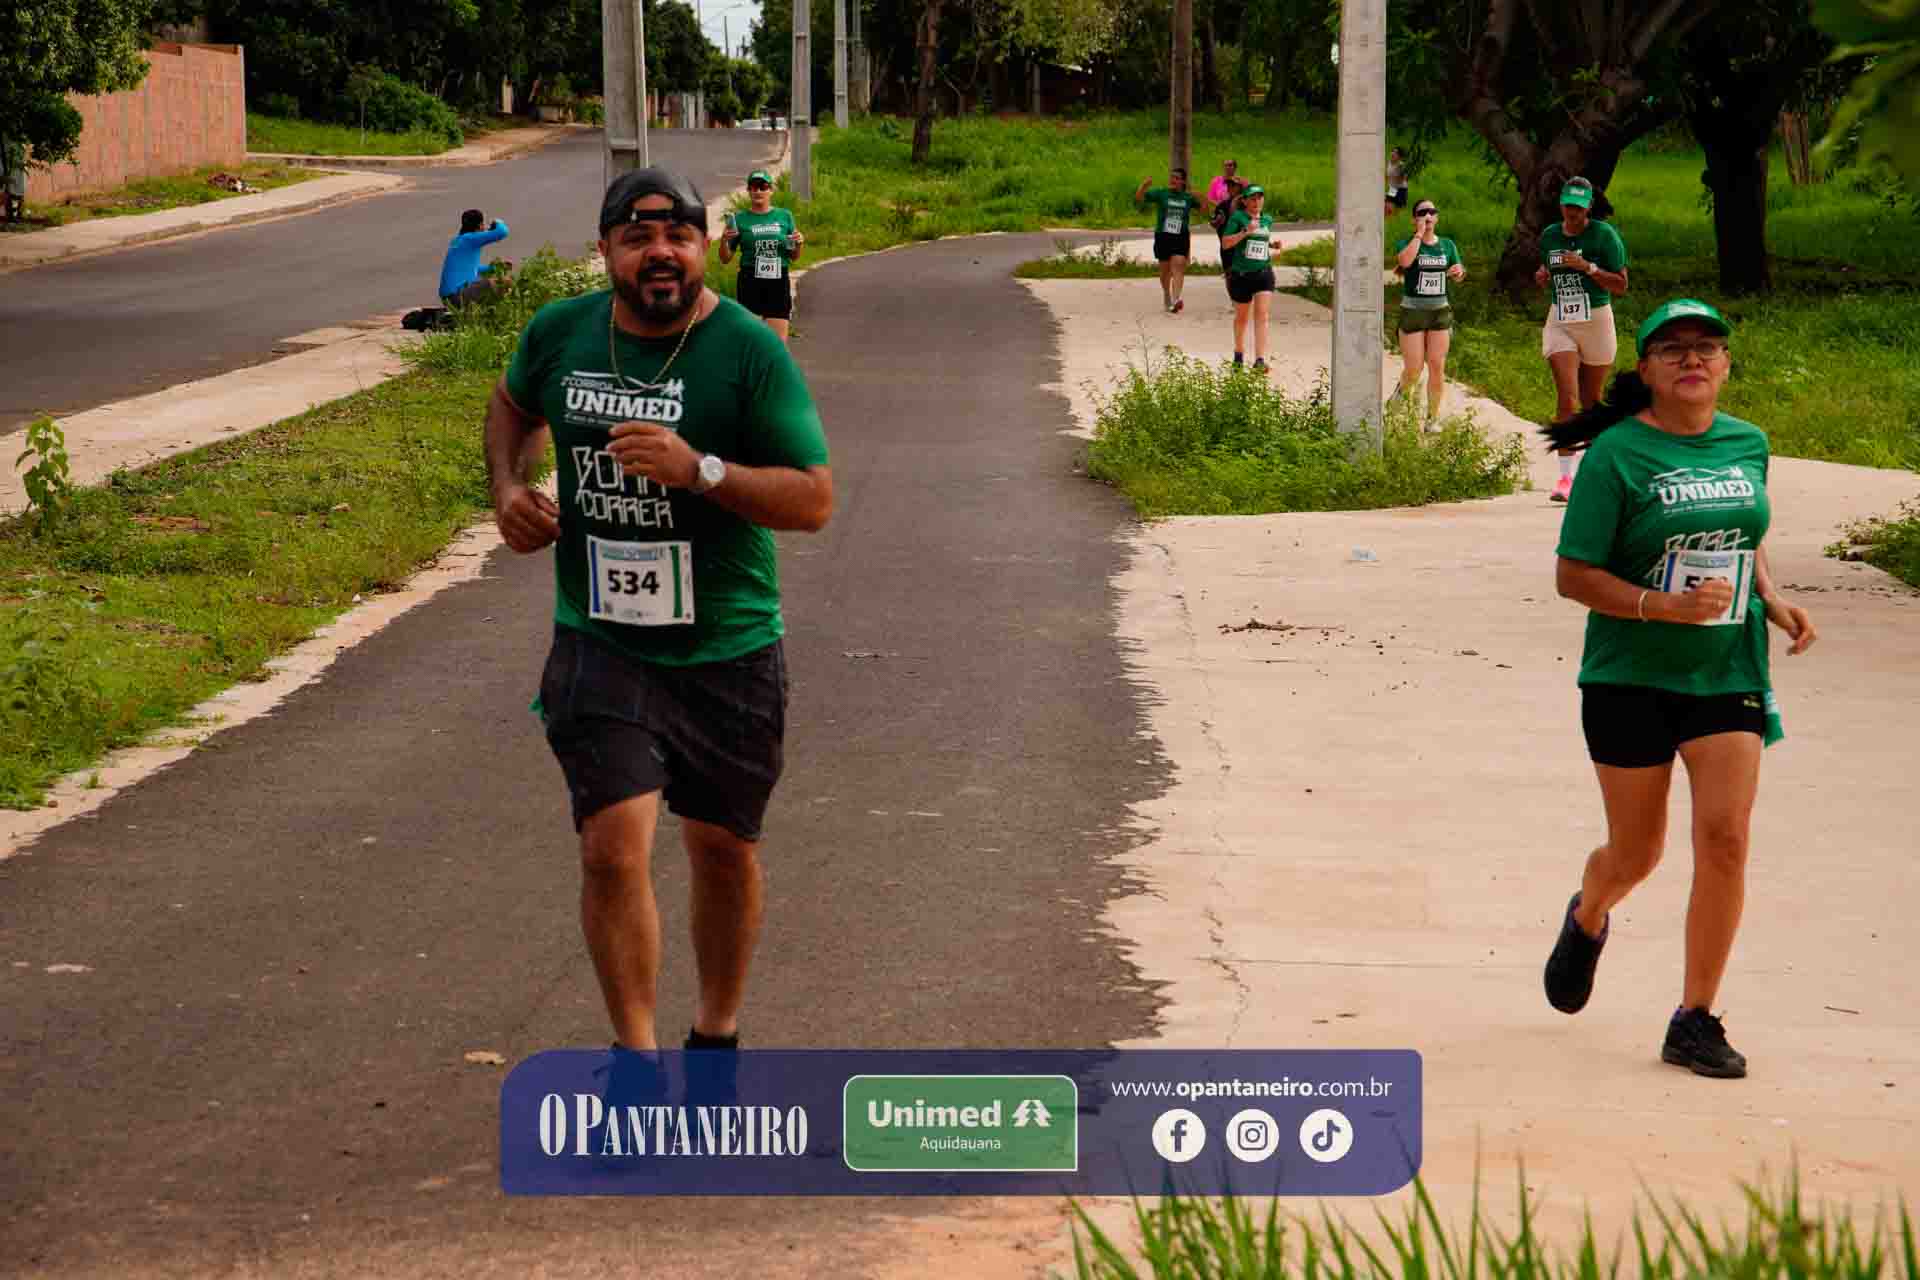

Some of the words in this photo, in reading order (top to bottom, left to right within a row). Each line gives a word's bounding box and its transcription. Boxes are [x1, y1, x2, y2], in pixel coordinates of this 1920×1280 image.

[1425, 279, 1438, 287] 701
[566, 387, 683, 422] UNIMED
[1659, 480, 1755, 505] UNIMED
[576, 489, 674, 529] CORRER
[607, 568, 660, 595] 534
